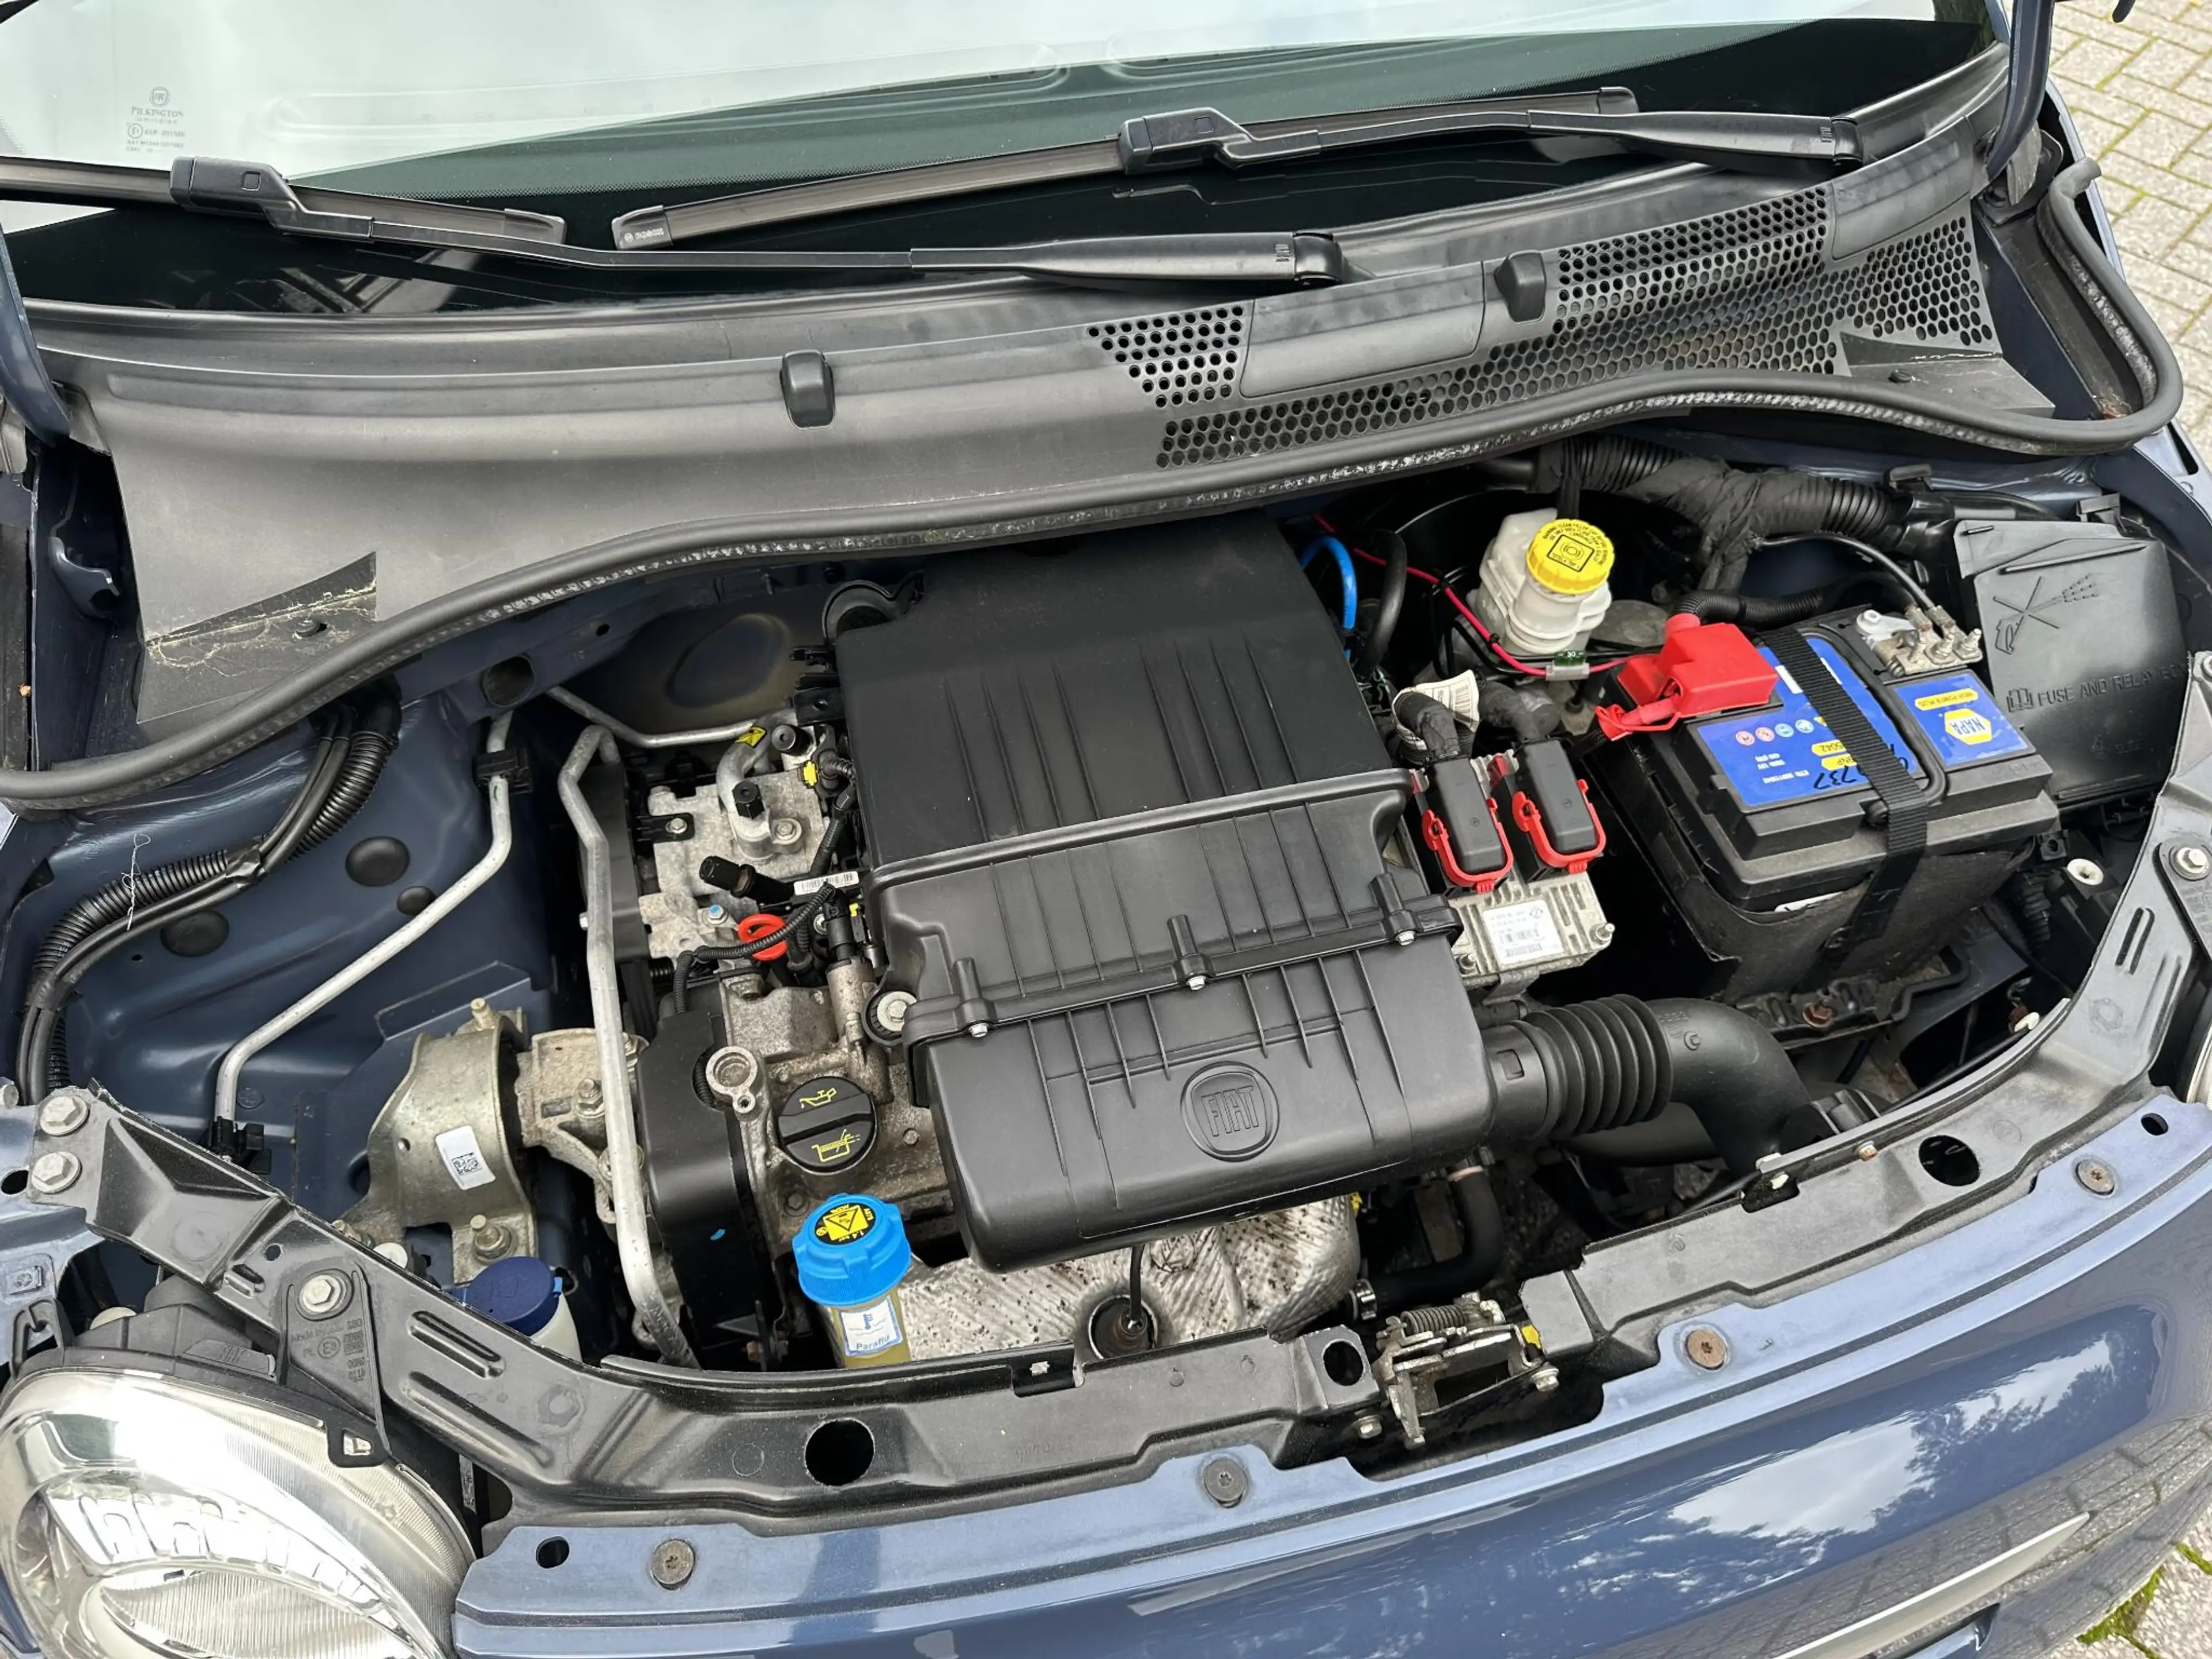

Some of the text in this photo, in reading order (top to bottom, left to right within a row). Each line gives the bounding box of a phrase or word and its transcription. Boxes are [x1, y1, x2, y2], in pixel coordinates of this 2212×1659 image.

[131, 106, 183, 118] PILKINGTON
[2037, 686, 2074, 707] FUSE
[2081, 680, 2108, 699] AND
[2112, 671, 2154, 690] RELAY
[1951, 717, 1984, 737] NAPA
[1201, 1085, 1260, 1137] FIAT
[856, 1334, 891, 1351] Paraflu
